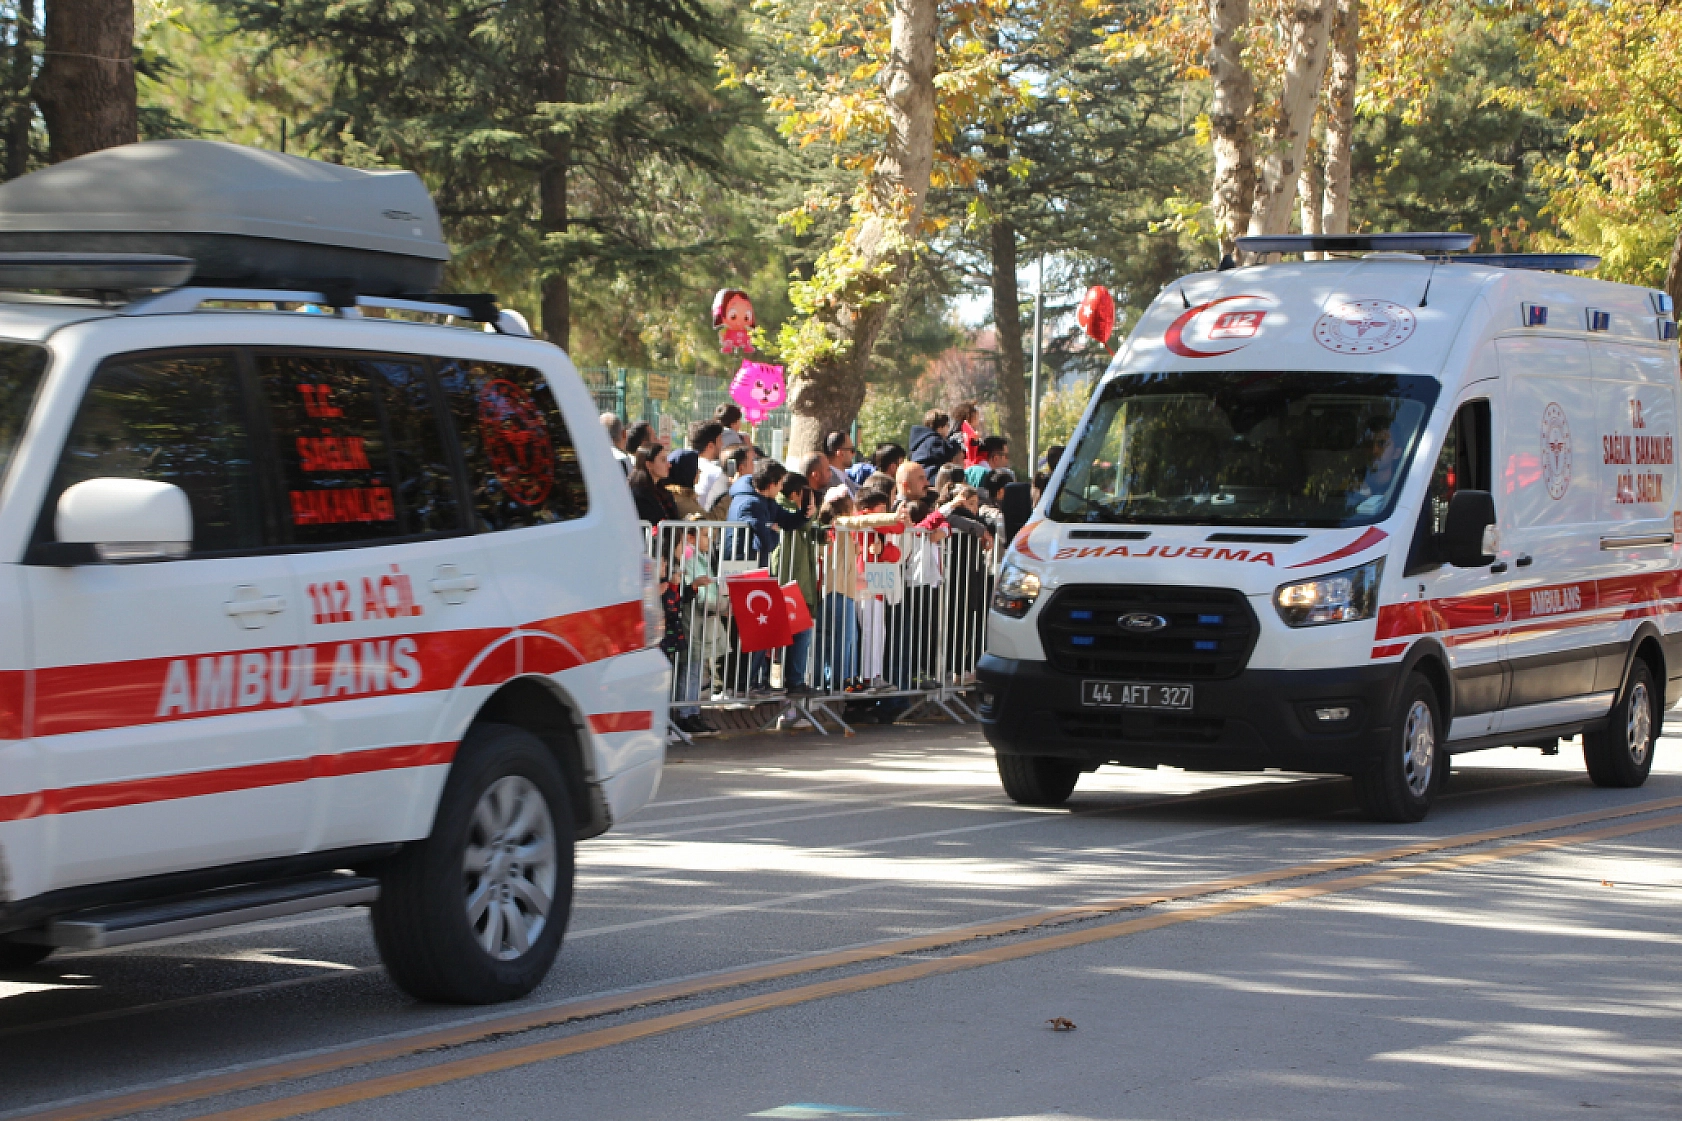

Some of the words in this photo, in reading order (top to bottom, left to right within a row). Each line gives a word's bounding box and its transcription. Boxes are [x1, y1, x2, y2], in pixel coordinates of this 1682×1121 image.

[1221, 312, 1258, 328] 112
[1603, 430, 1632, 465] SAĞLIK
[1637, 468, 1663, 503] SAĞLIK
[306, 580, 354, 625] 112
[361, 563, 424, 621] ACİL
[867, 567, 895, 589] POLİS
[1530, 585, 1581, 616] AMBULANS
[153, 637, 422, 718] AMBULANS
[1092, 684, 1112, 702] 44
[1121, 685, 1151, 705] AFT
[1160, 687, 1190, 706] 327
